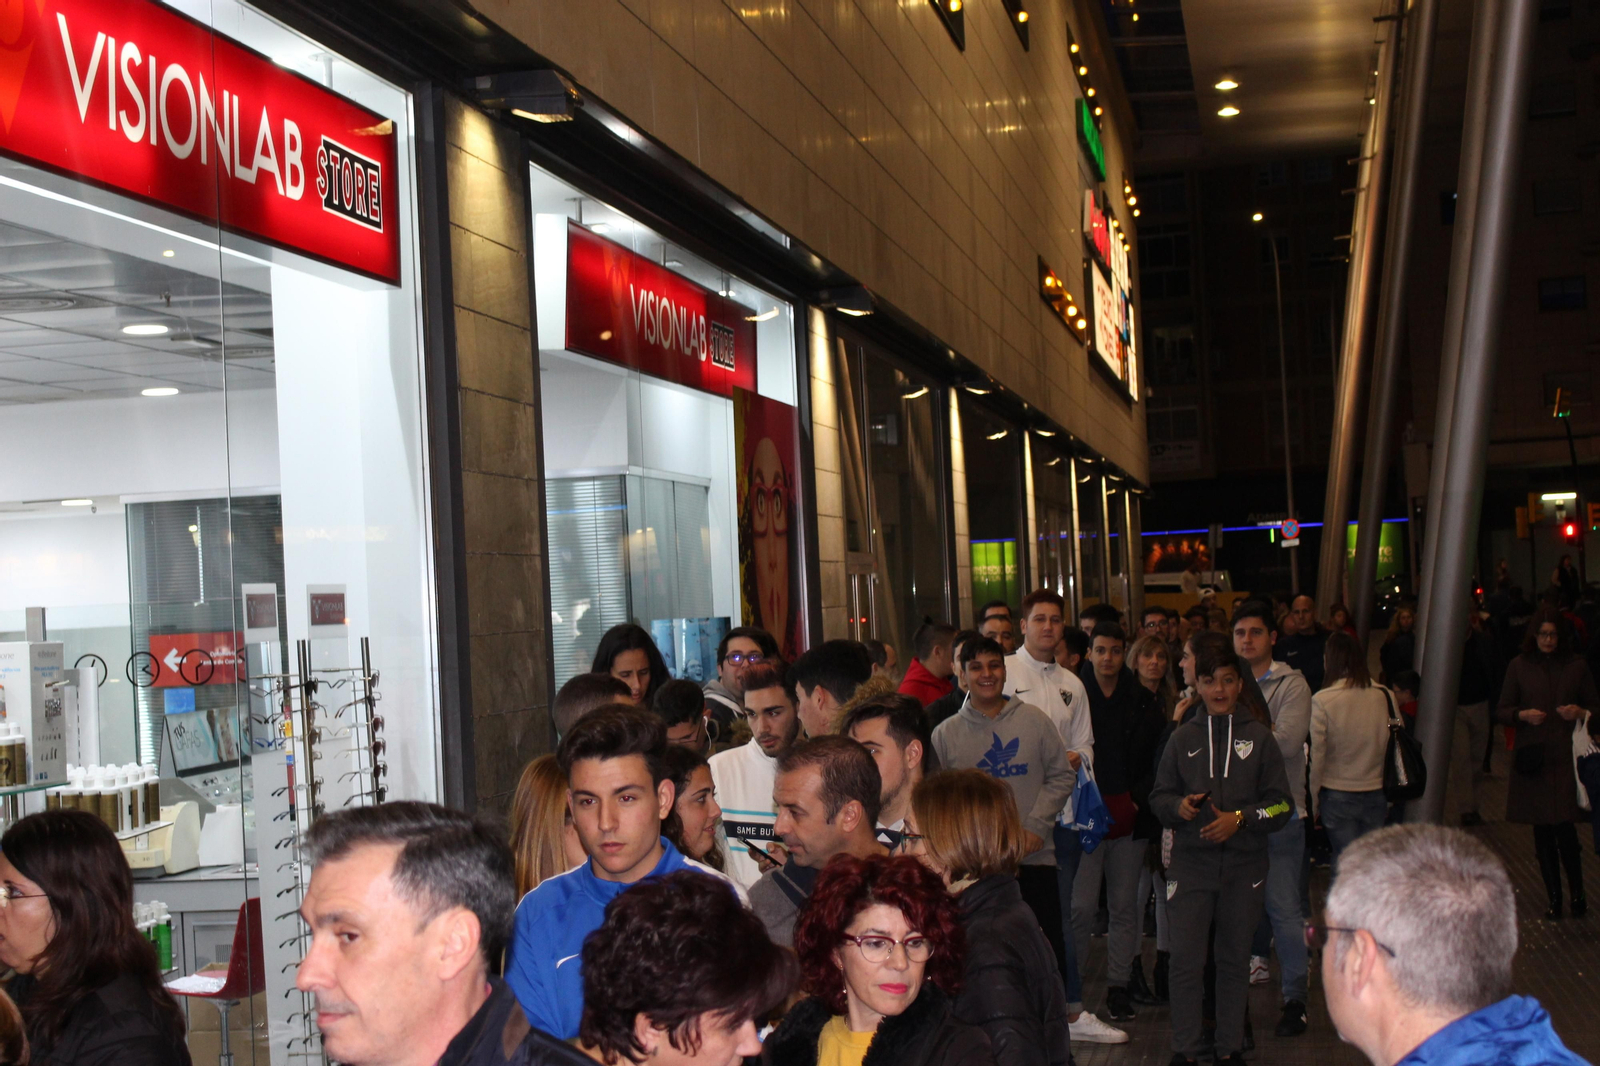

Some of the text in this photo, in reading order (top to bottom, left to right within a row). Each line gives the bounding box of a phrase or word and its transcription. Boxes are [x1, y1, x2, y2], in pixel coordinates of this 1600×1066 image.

[56, 11, 380, 222] VISIONLAB STORE
[630, 283, 734, 366] VISIONLAB STORE
[1247, 510, 1303, 523] ADMIRL
[173, 722, 186, 740] TUS
[985, 760, 1029, 778] didas
[736, 826, 757, 835] SAME
